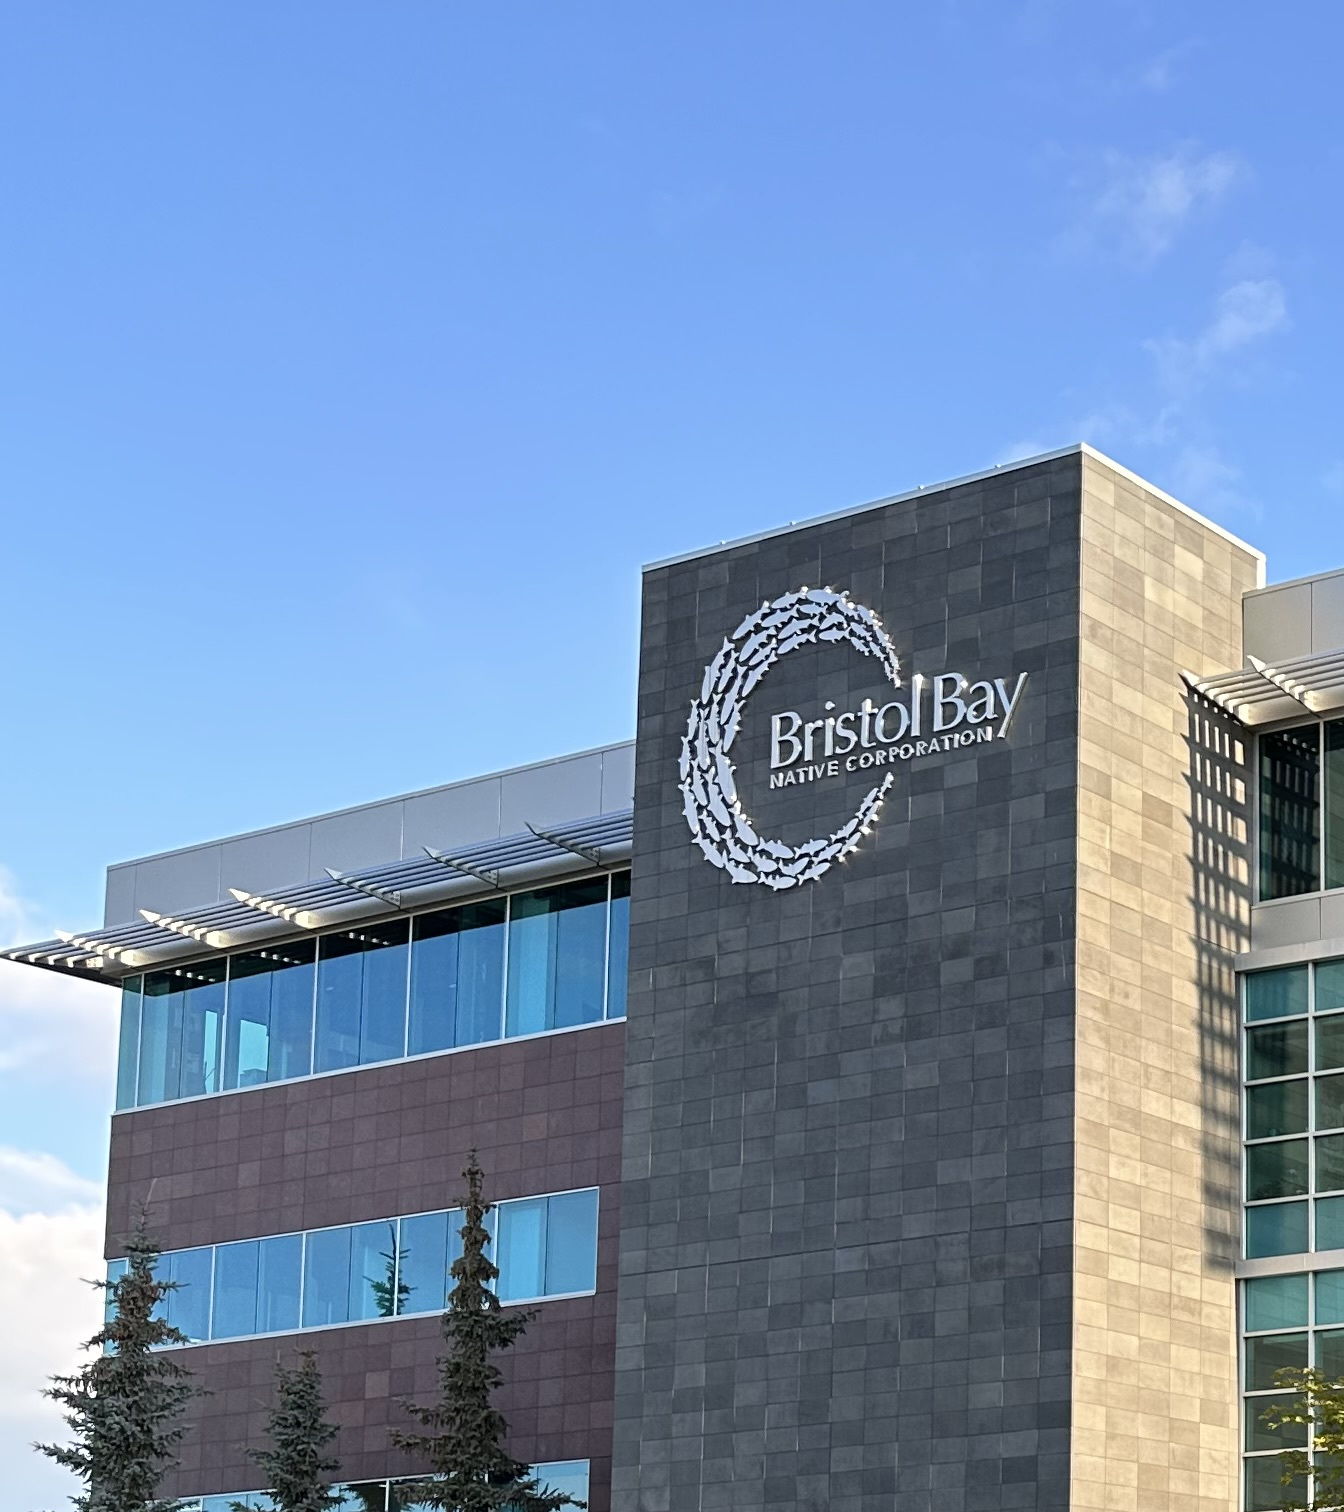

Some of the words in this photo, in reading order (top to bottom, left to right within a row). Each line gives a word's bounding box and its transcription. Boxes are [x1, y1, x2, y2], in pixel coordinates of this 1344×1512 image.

[769, 673, 923, 770] Bristol
[933, 671, 1030, 739] Bay
[769, 760, 840, 790] NATIVE
[846, 726, 993, 772] CORPORATION
